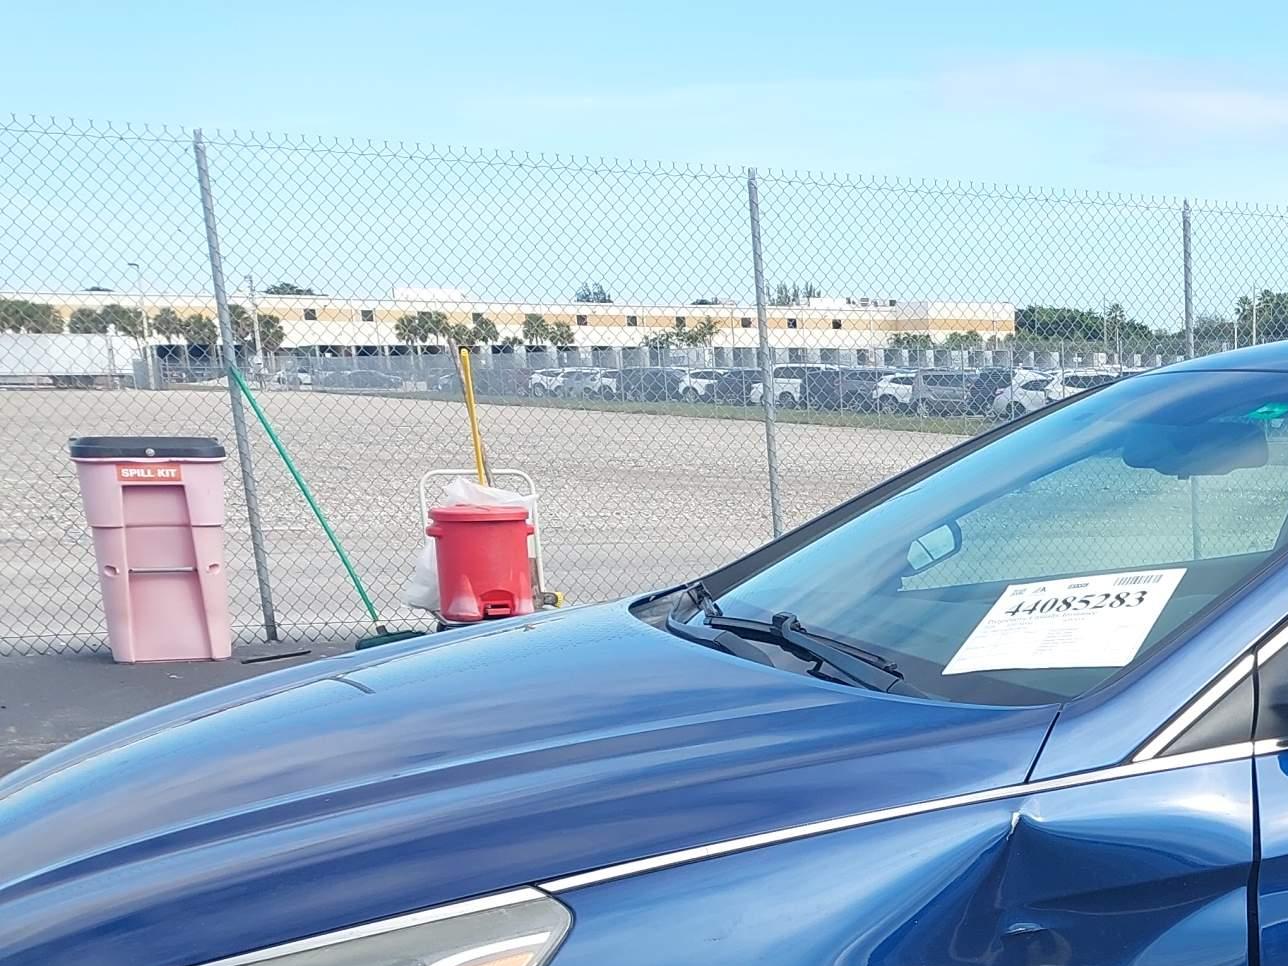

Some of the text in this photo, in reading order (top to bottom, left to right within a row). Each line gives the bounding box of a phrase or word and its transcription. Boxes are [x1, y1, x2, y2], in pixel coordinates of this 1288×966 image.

[121, 468, 177, 478] SPILL KIT
[1004, 590, 1148, 617] 44085283
